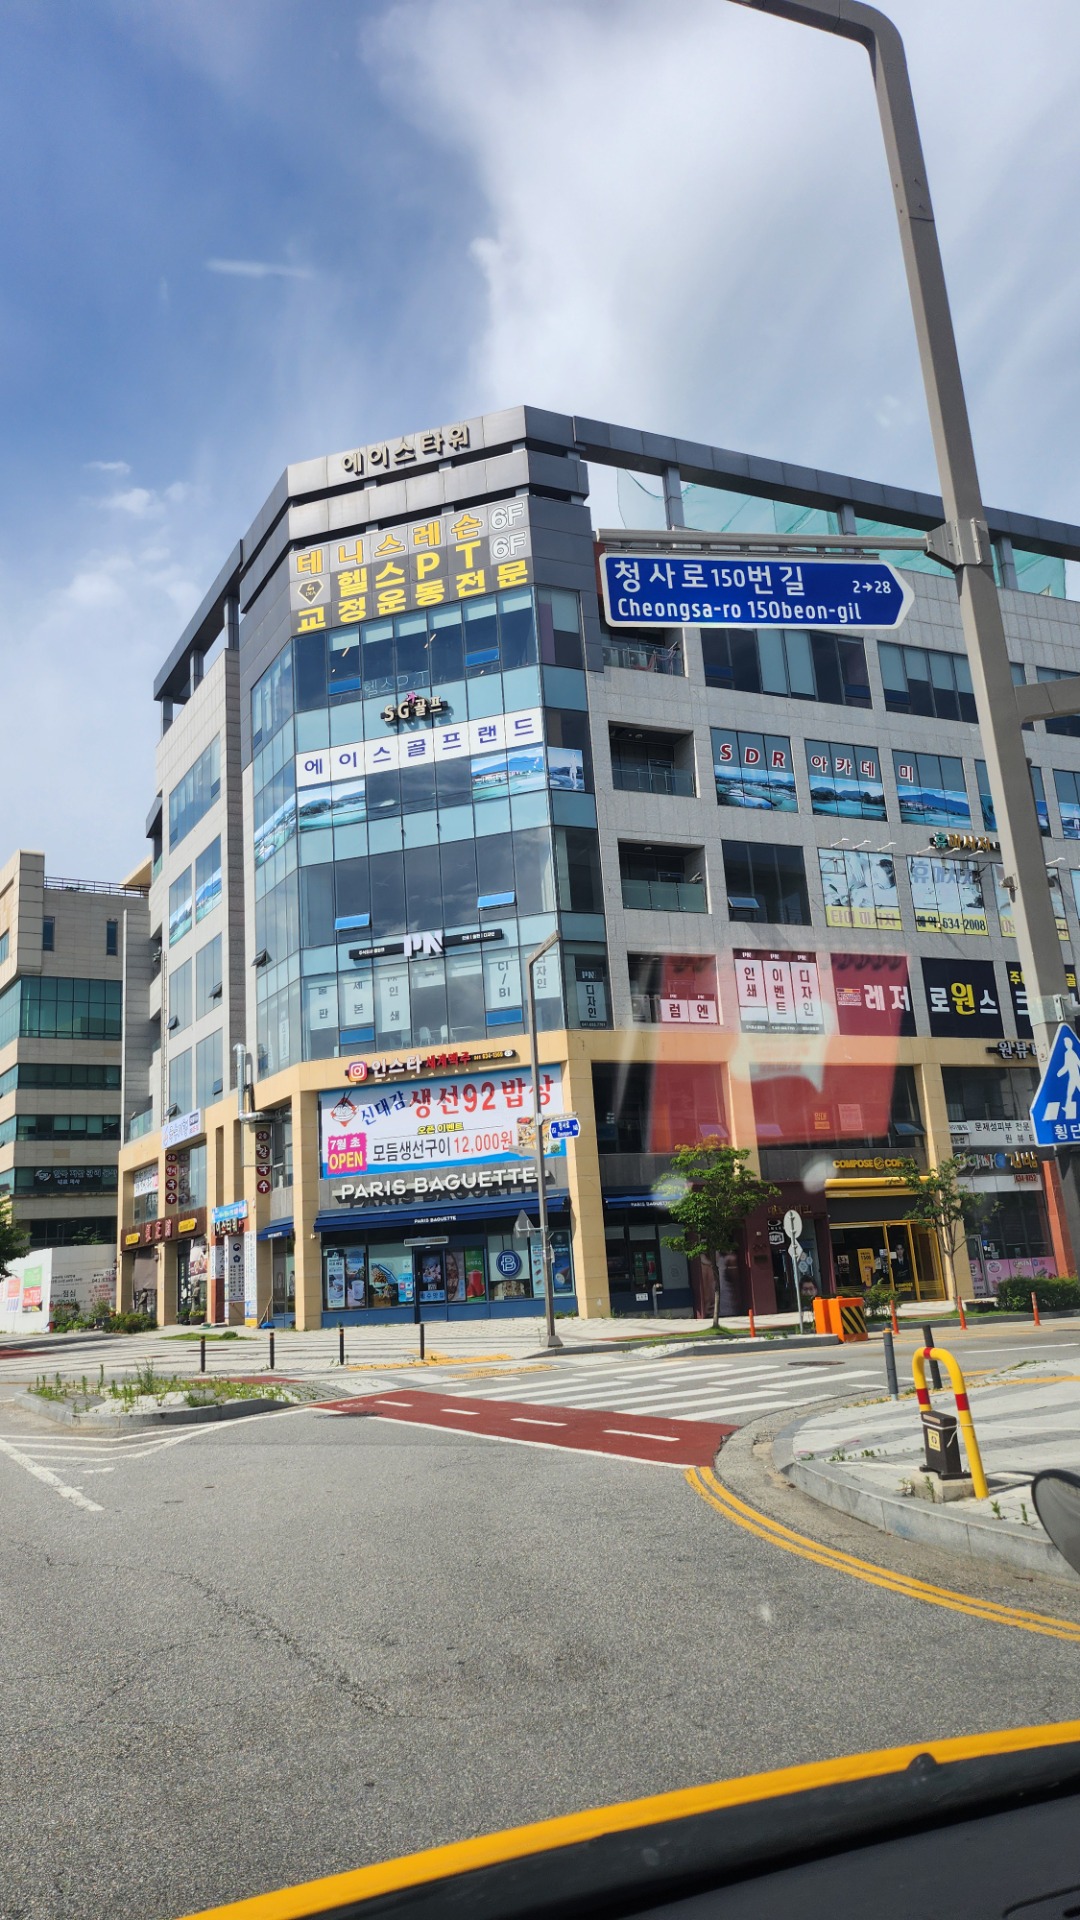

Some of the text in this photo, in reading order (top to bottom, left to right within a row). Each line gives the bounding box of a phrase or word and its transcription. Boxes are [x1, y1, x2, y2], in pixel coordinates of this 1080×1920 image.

[341, 424, 470, 475] 에이스타워
[490, 501, 526, 530] 6F
[491, 531, 528, 561] 6F
[617, 598, 862, 624] Cheongsa-ro 150beon-gil
[304, 717, 534, 775] 에이스골프랜드
[744, 967, 757, 998] 인쇄
[772, 968, 787, 1015] 이벤트
[799, 969, 814, 1017] 디자인
[585, 984, 597, 1018] 디자인
[361, 1090, 406, 1126] 신대감
[437, 1121, 464, 1132] 이벤트
[974, 1121, 1030, 1132] 문제성피부 전문
[329, 1138, 347, 1151] 7월
[373, 1130, 513, 1162] 모듬생선구이 12,000원
[329, 1151, 363, 1170] OPEN
[833, 1159, 874, 1169] COMPOSE
[341, 1167, 537, 1200] PARIS BAGUETTE
